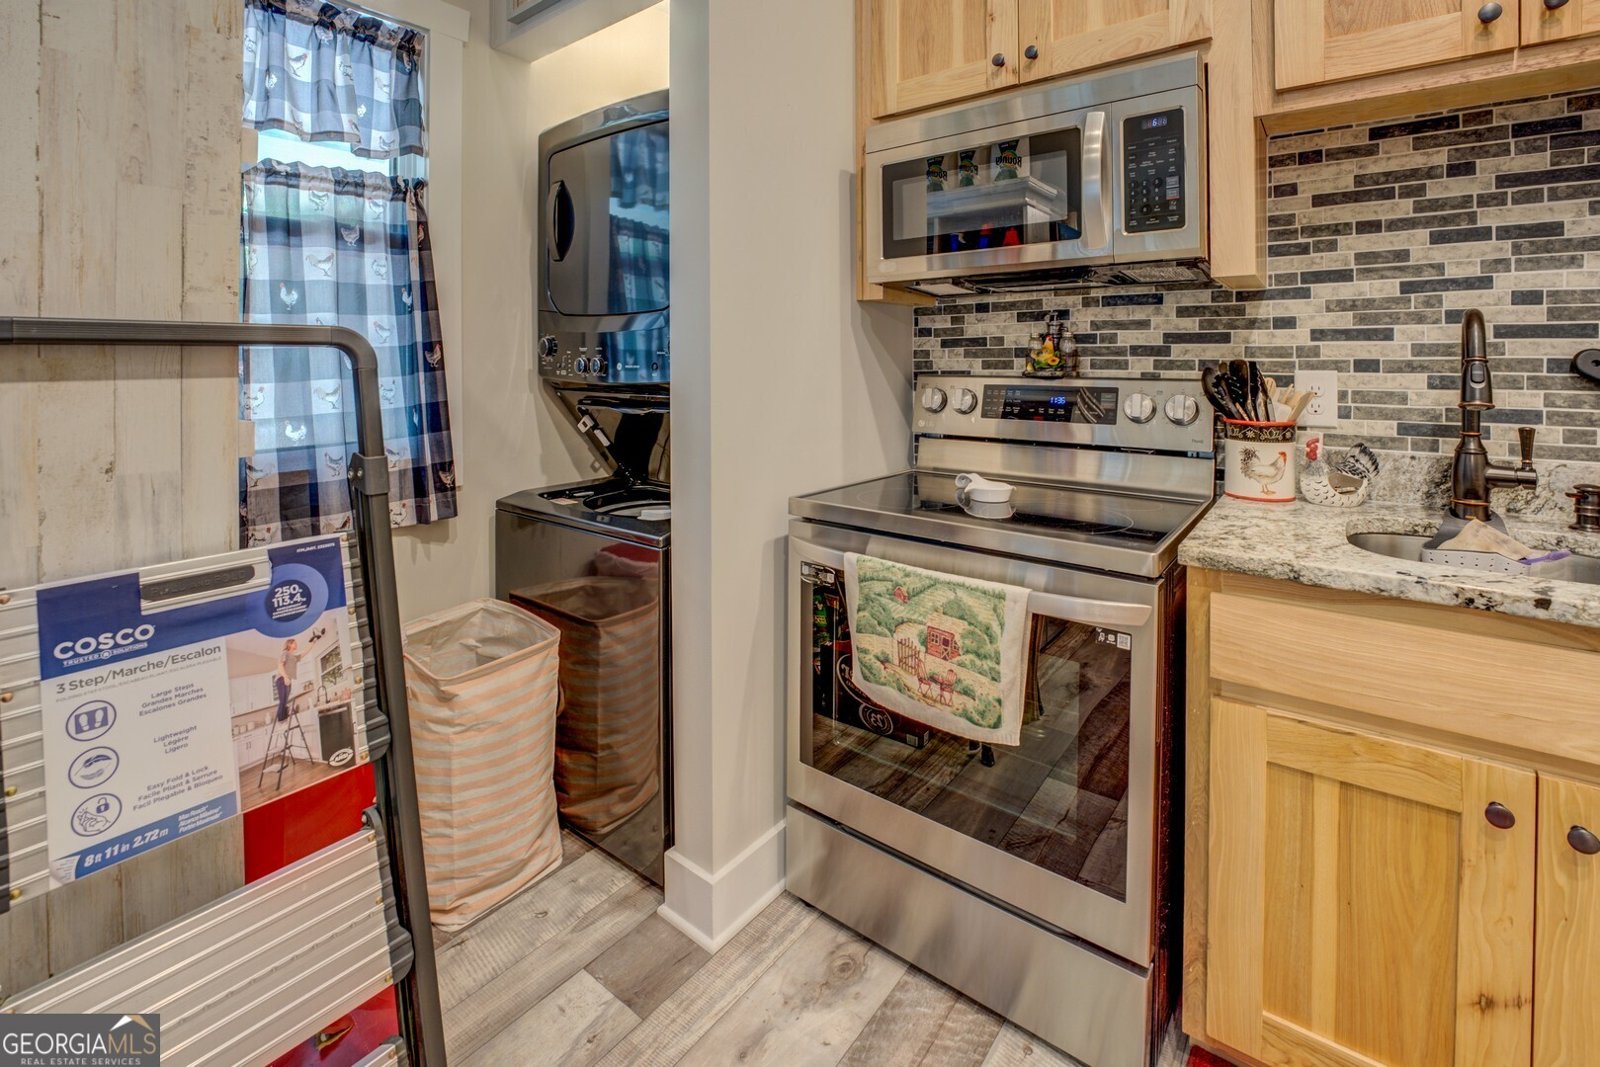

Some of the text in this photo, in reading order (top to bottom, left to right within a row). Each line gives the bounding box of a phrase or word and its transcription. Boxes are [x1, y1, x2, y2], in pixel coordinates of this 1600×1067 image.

[274, 584, 299, 598] 250
[53, 623, 155, 660] COSCO
[56, 683, 66, 694] 3
[69, 645, 222, 691] Step/Marche/Escalon
[141, 687, 204, 709] Grandes Marches
[151, 683, 194, 699] Large Steps
[138, 693, 207, 717] Escalones Grandes
[153, 725, 197, 743] Lightweight
[164, 742, 189, 754] Ligero
[147, 781, 165, 791] Easy
[166, 774, 183, 785] Fold
[191, 765, 208, 775] Lock
[137, 790, 161, 802] Facile
[163, 781, 183, 793] Pliant
[153, 788, 185, 804] Plegable
[83, 854, 95, 867] 8
[104, 844, 120, 859] 11
[120, 843, 130, 853] in
[132, 828, 160, 849] 2.72
[159, 828, 169, 838] m
